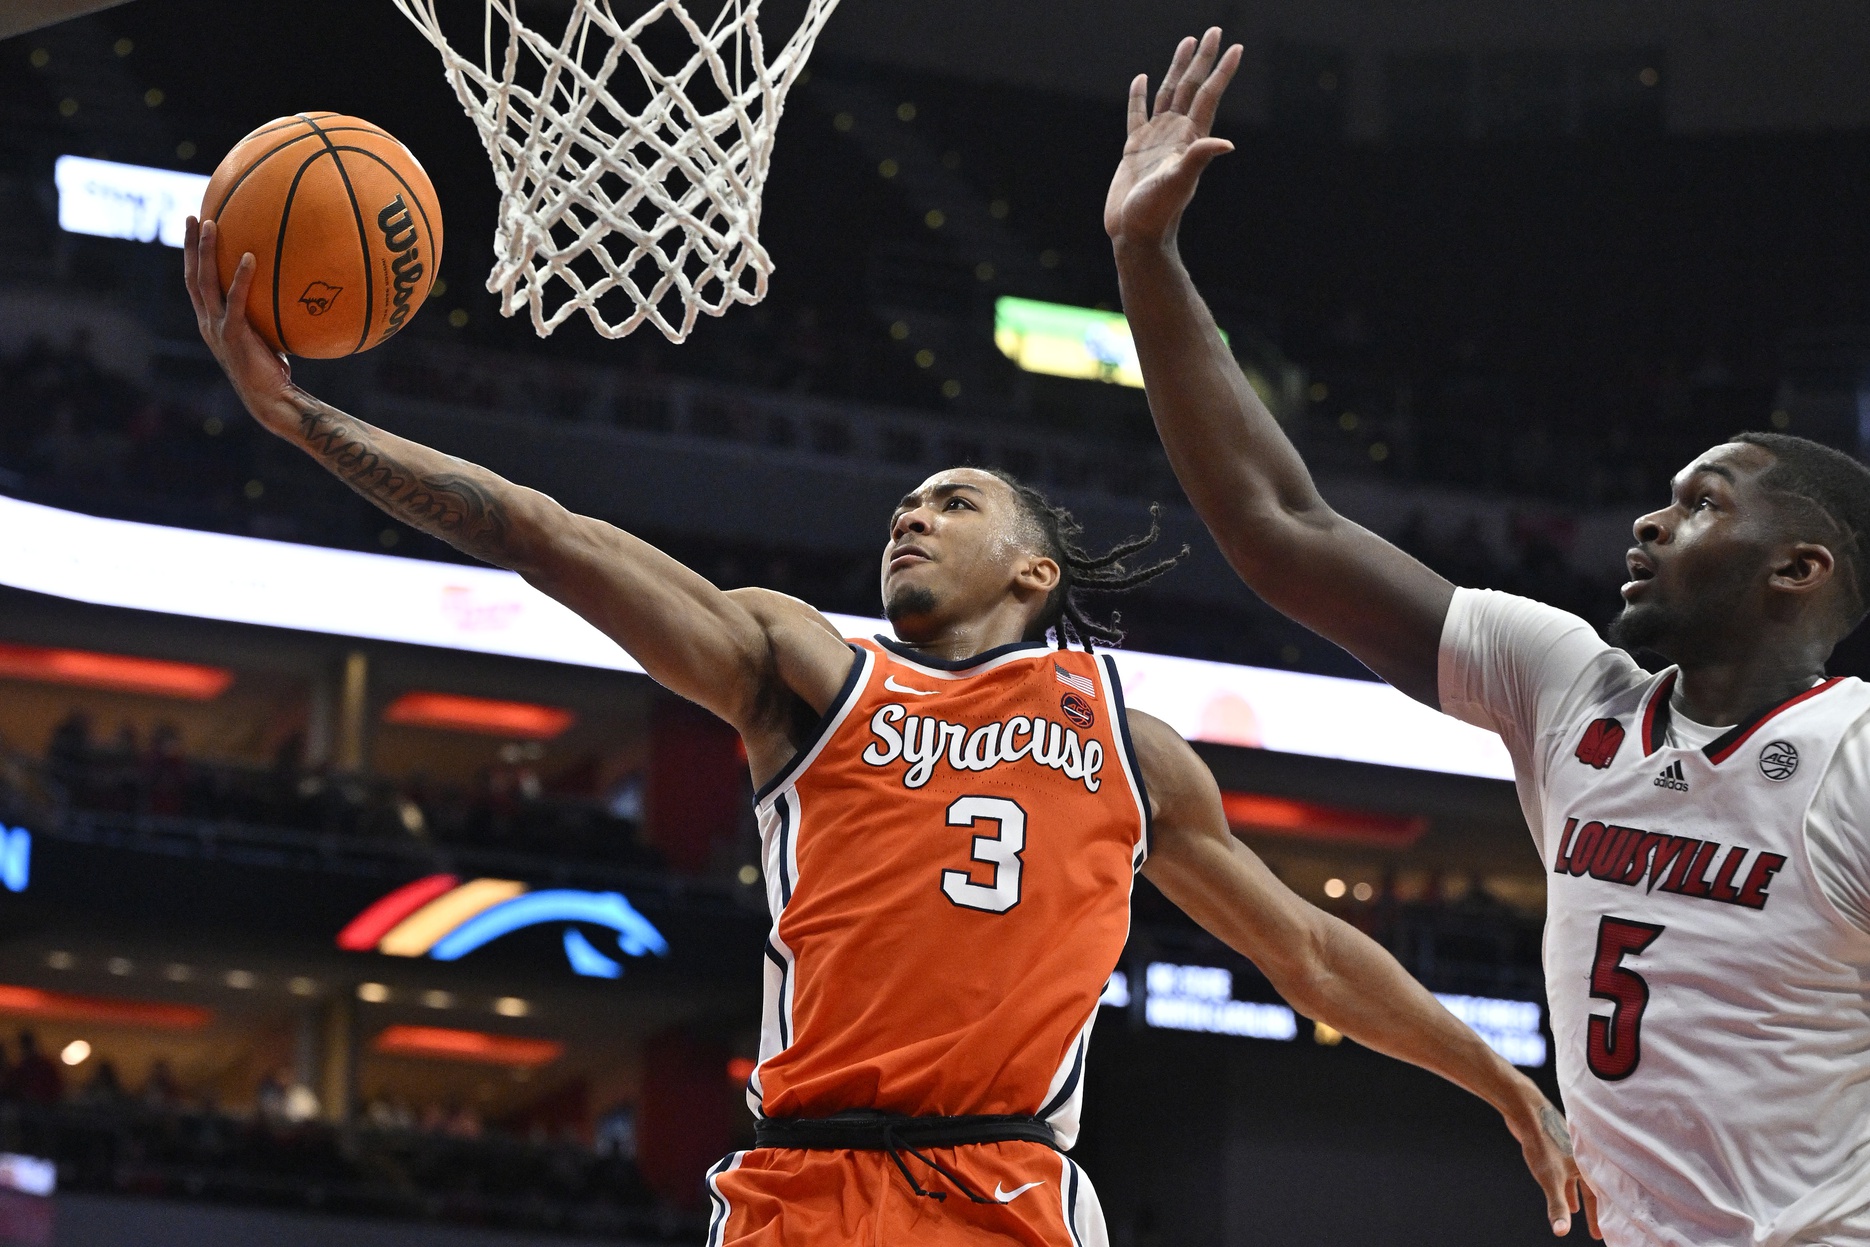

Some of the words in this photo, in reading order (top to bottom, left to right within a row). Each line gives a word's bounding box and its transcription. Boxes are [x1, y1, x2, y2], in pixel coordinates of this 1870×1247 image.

[376, 193, 423, 344] Wilson
[862, 703, 1103, 793] Syracuse
[1653, 776, 1689, 792] adidas
[1764, 752, 1797, 766] ACC
[940, 794, 1027, 915] 3
[1554, 817, 1788, 910] LOUISVILLE
[1586, 914, 1666, 1081] 5
